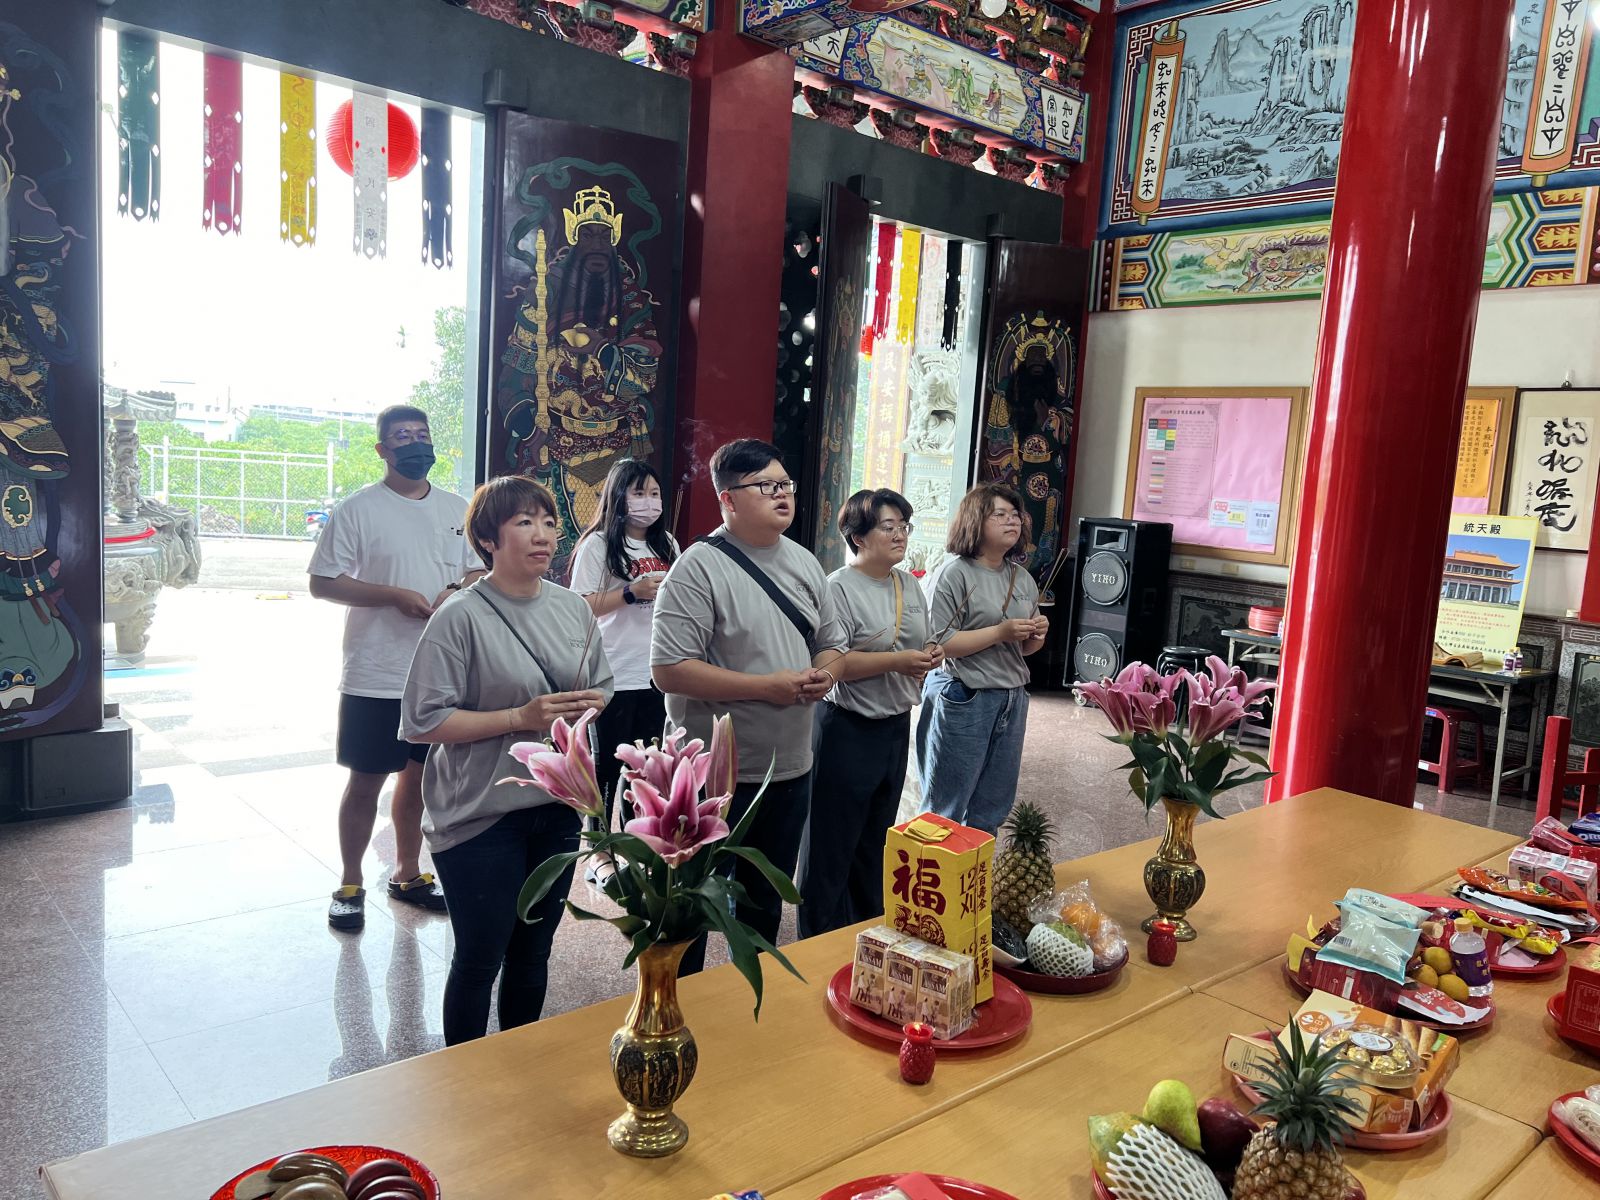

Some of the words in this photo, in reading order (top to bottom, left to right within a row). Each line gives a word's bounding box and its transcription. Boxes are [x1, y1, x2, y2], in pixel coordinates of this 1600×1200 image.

[1463, 522, 1501, 535] 統天殿
[1091, 572, 1116, 585] YIHO
[1083, 653, 1108, 667] YIHO
[892, 849, 947, 916] 福
